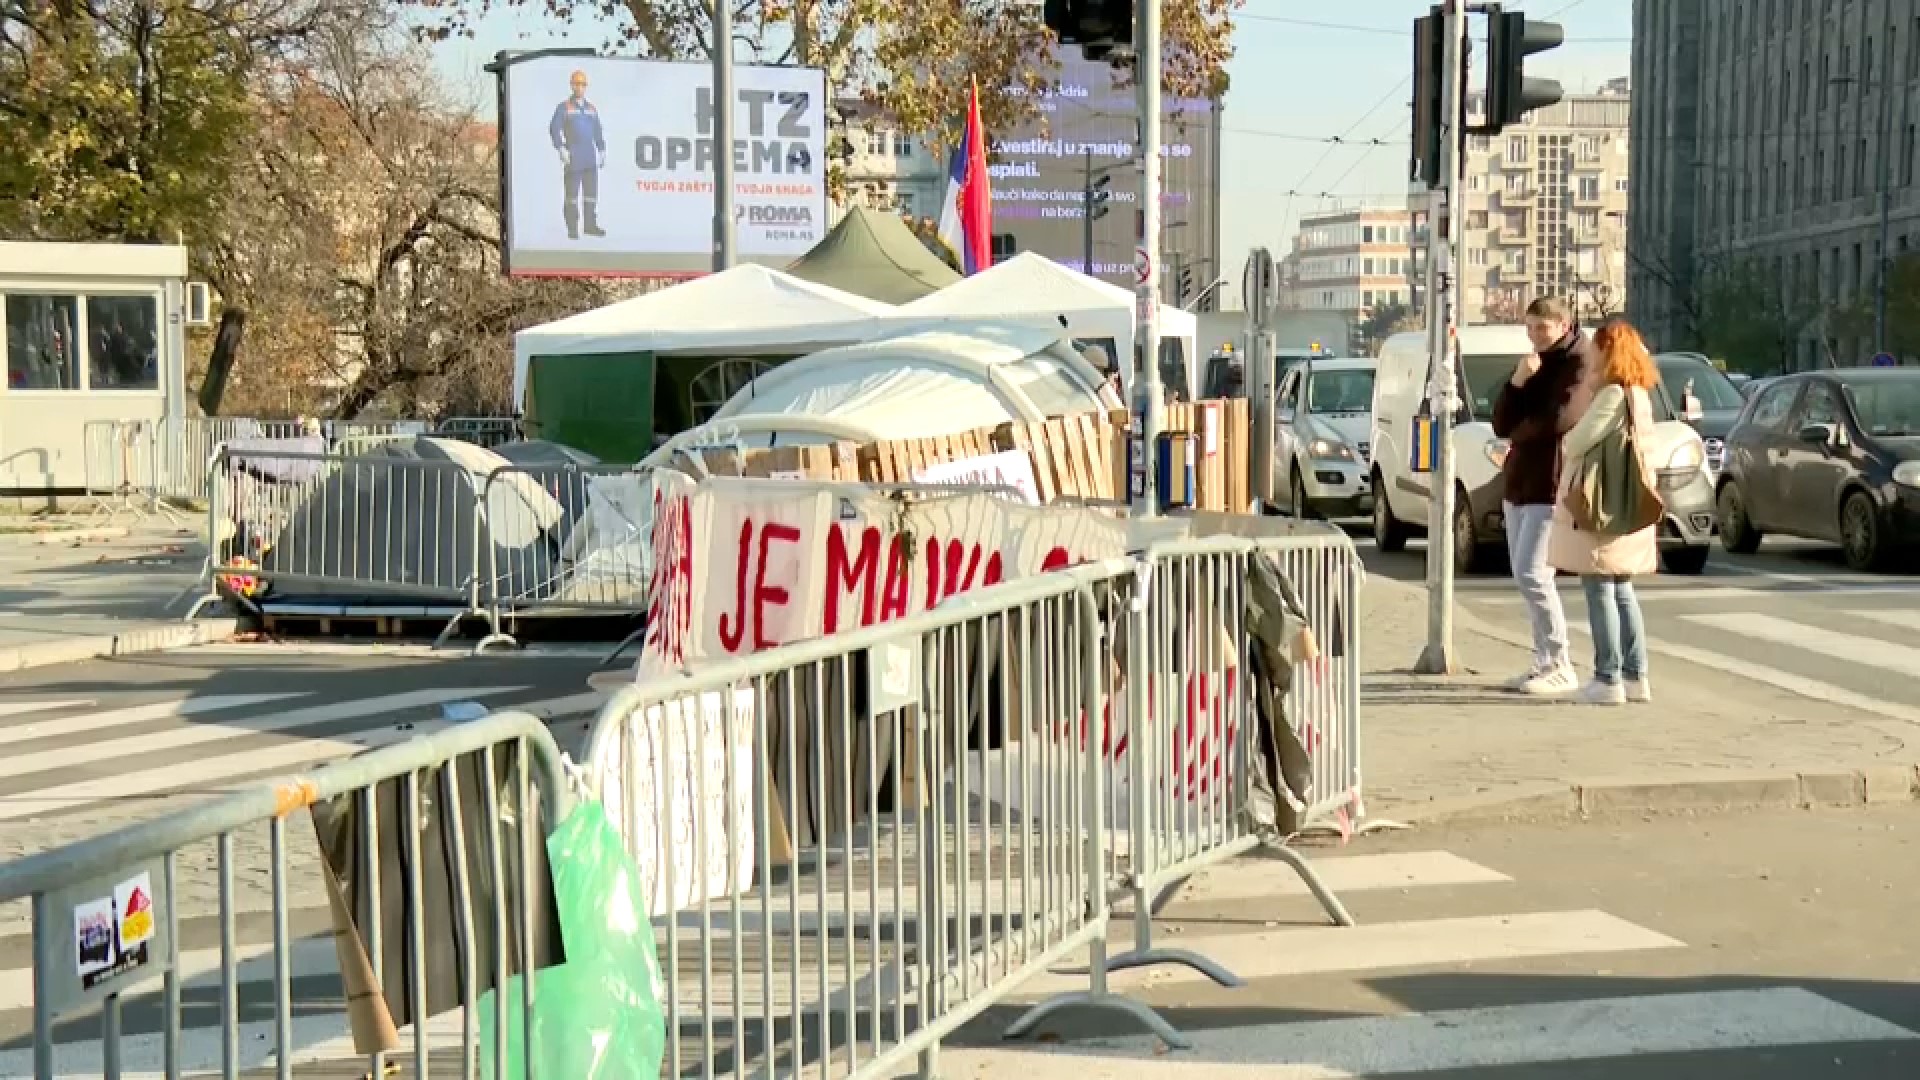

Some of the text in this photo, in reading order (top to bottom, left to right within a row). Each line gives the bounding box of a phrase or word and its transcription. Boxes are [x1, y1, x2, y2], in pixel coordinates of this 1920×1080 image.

[635, 136, 813, 175] OPREMA
[750, 205, 813, 222] ROMA
[719, 517, 801, 653] JE
